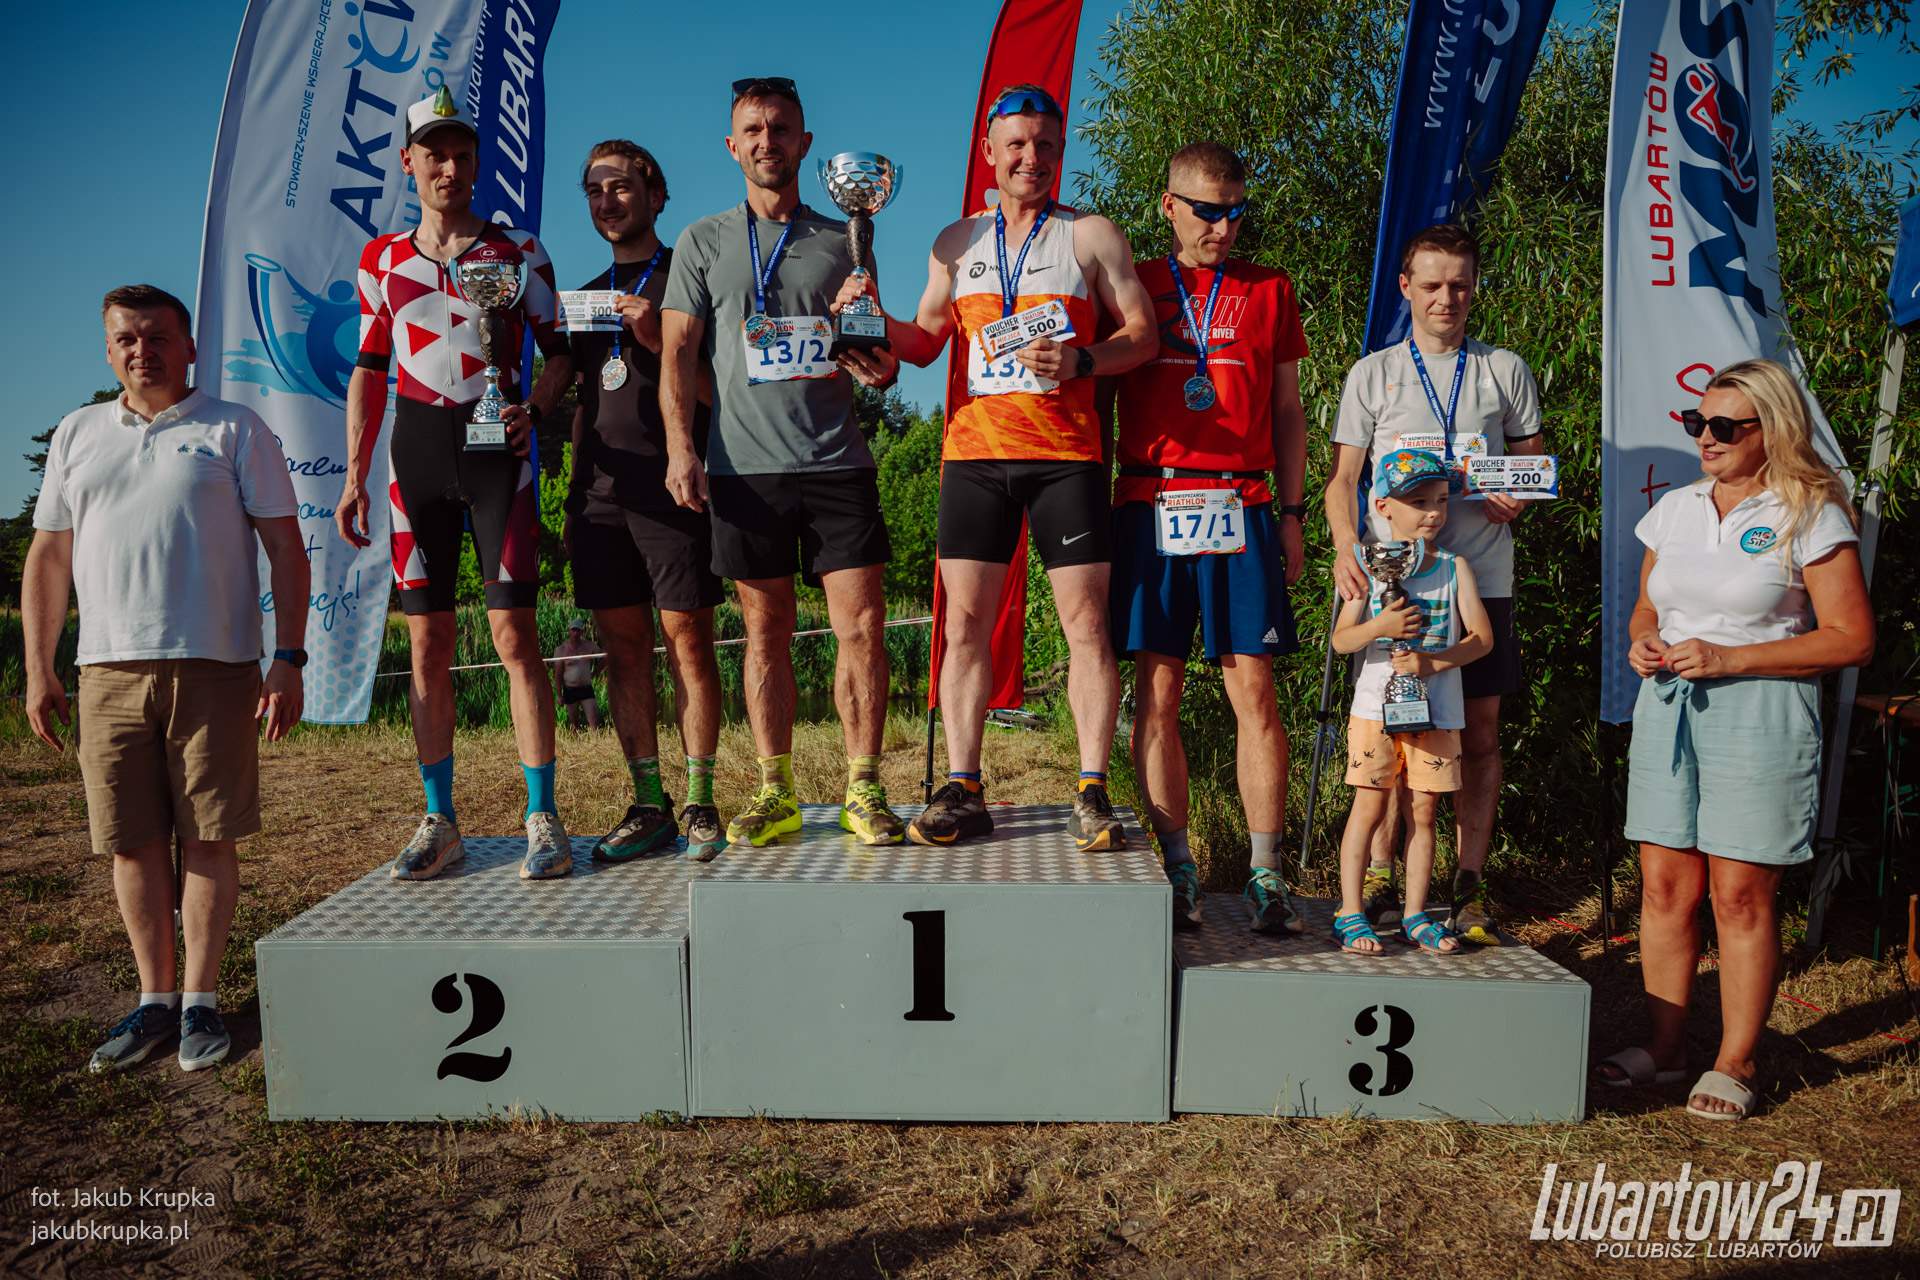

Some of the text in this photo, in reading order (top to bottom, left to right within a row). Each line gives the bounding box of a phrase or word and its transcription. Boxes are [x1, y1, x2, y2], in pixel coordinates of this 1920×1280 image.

[286, 90, 314, 208] STOWARZYSZENIE
[1643, 51, 1676, 287] LUBARTÓW
[590, 306, 612, 317] 300
[984, 316, 1020, 335] VOUCHER
[1028, 318, 1057, 337] 500
[1212, 328, 1236, 340] RIVER
[759, 338, 827, 366] 13/2
[1471, 459, 1506, 468] VOUCHER
[1511, 472, 1542, 485] 200
[1168, 512, 1236, 540] 17/1
[903, 909, 956, 1022] 1
[431, 972, 513, 1083] 2
[1347, 1004, 1416, 1098] 3
